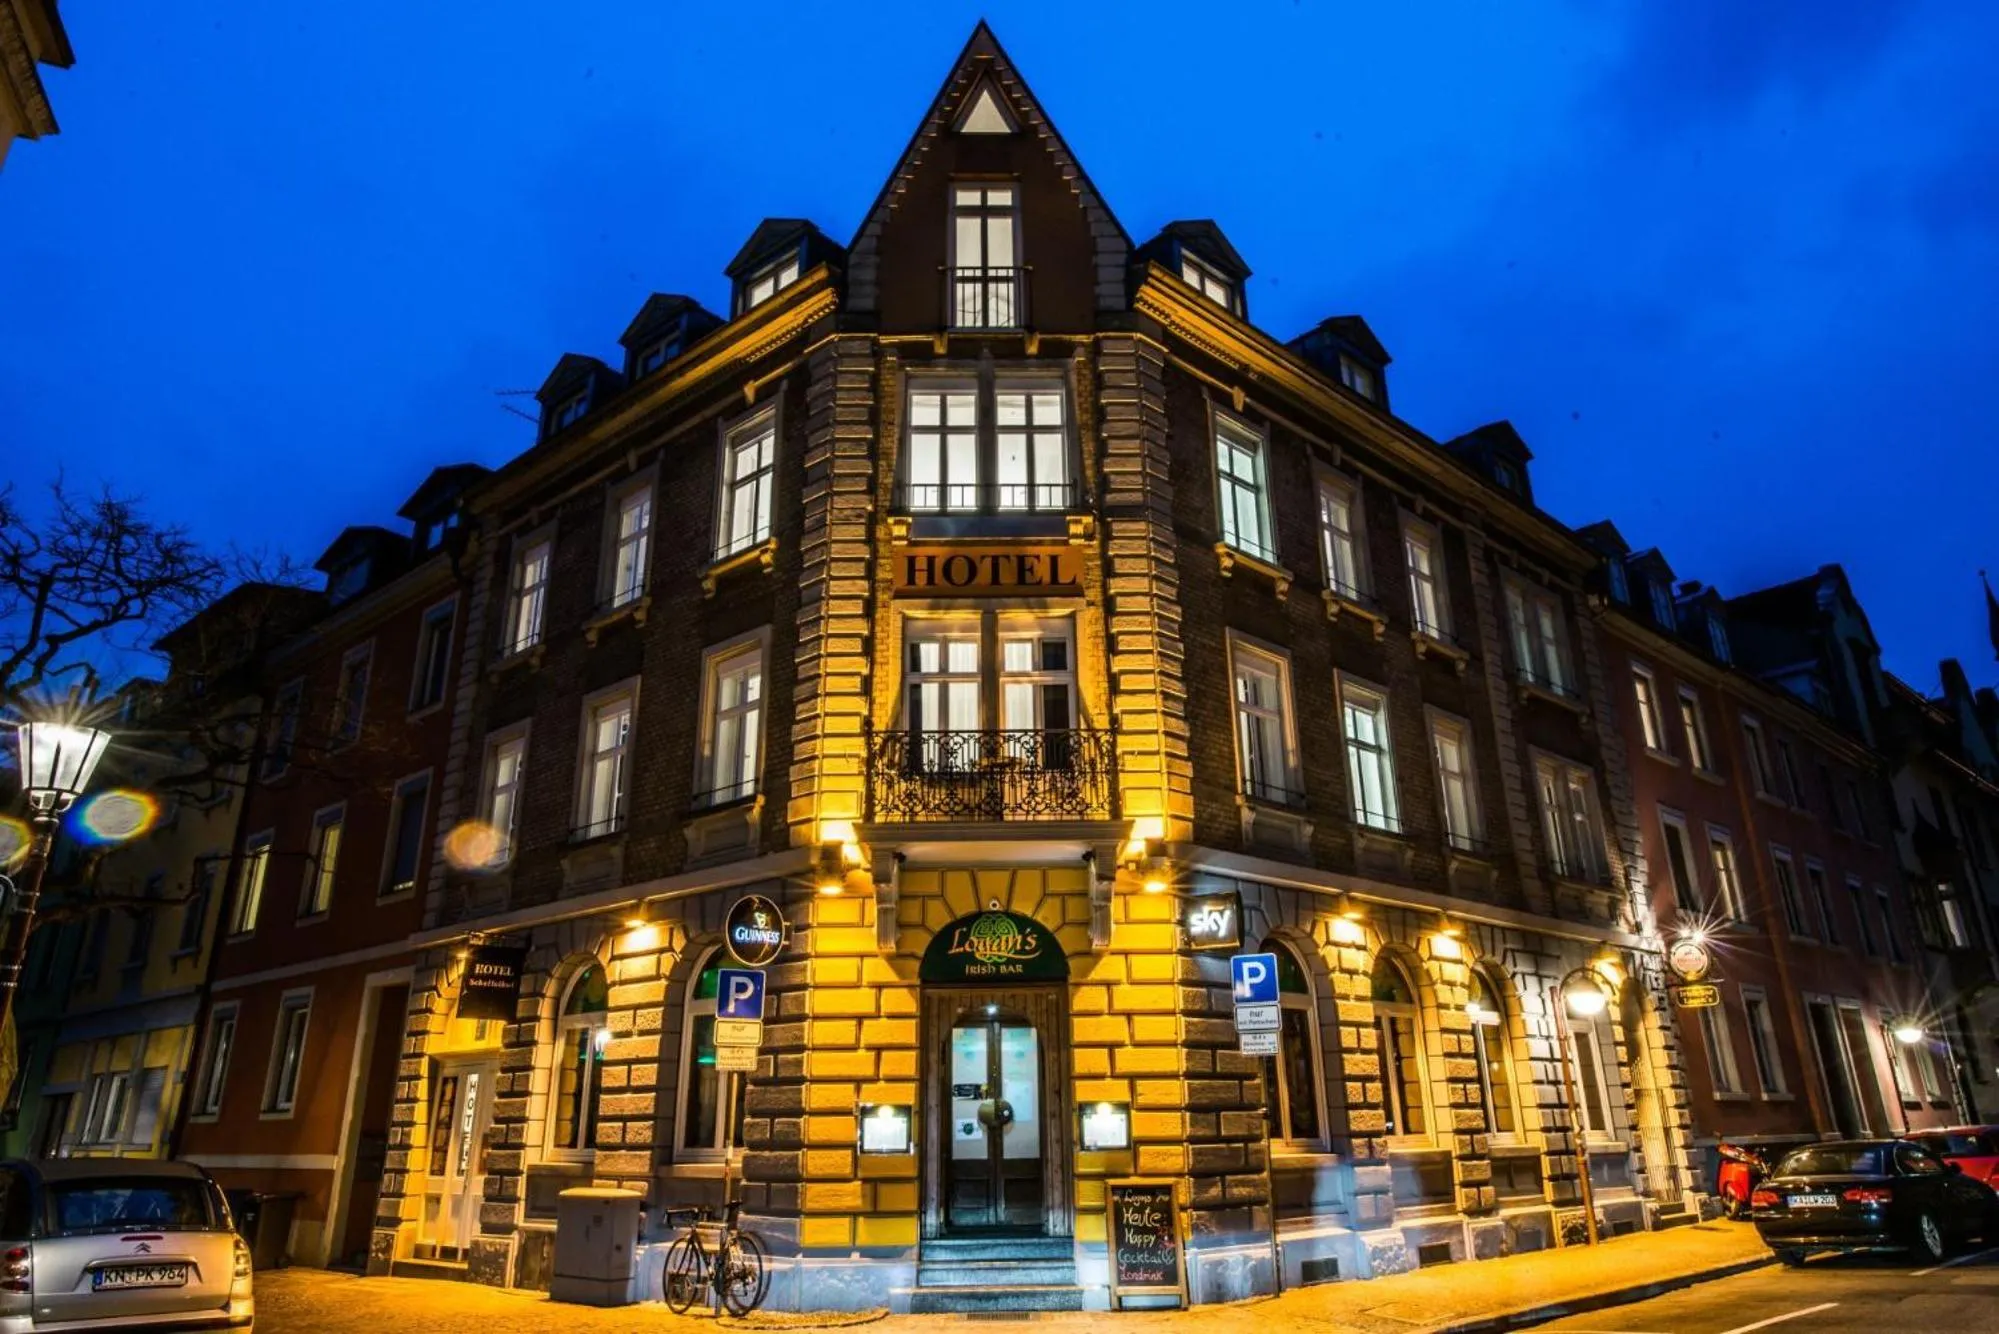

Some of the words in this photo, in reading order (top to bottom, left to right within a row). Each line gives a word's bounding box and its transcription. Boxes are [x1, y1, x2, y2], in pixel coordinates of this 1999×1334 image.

[905, 554, 1077, 587] HOTEL
[1189, 905, 1232, 938] sky
[475, 963, 514, 976] HOTEL
[1000, 964, 1024, 974] BAR
[1241, 961, 1267, 998] P
[727, 976, 755, 1013] P
[1124, 1227, 1157, 1248] Happy
[103, 1268, 125, 1283] KN
[136, 1267, 155, 1281] PK
